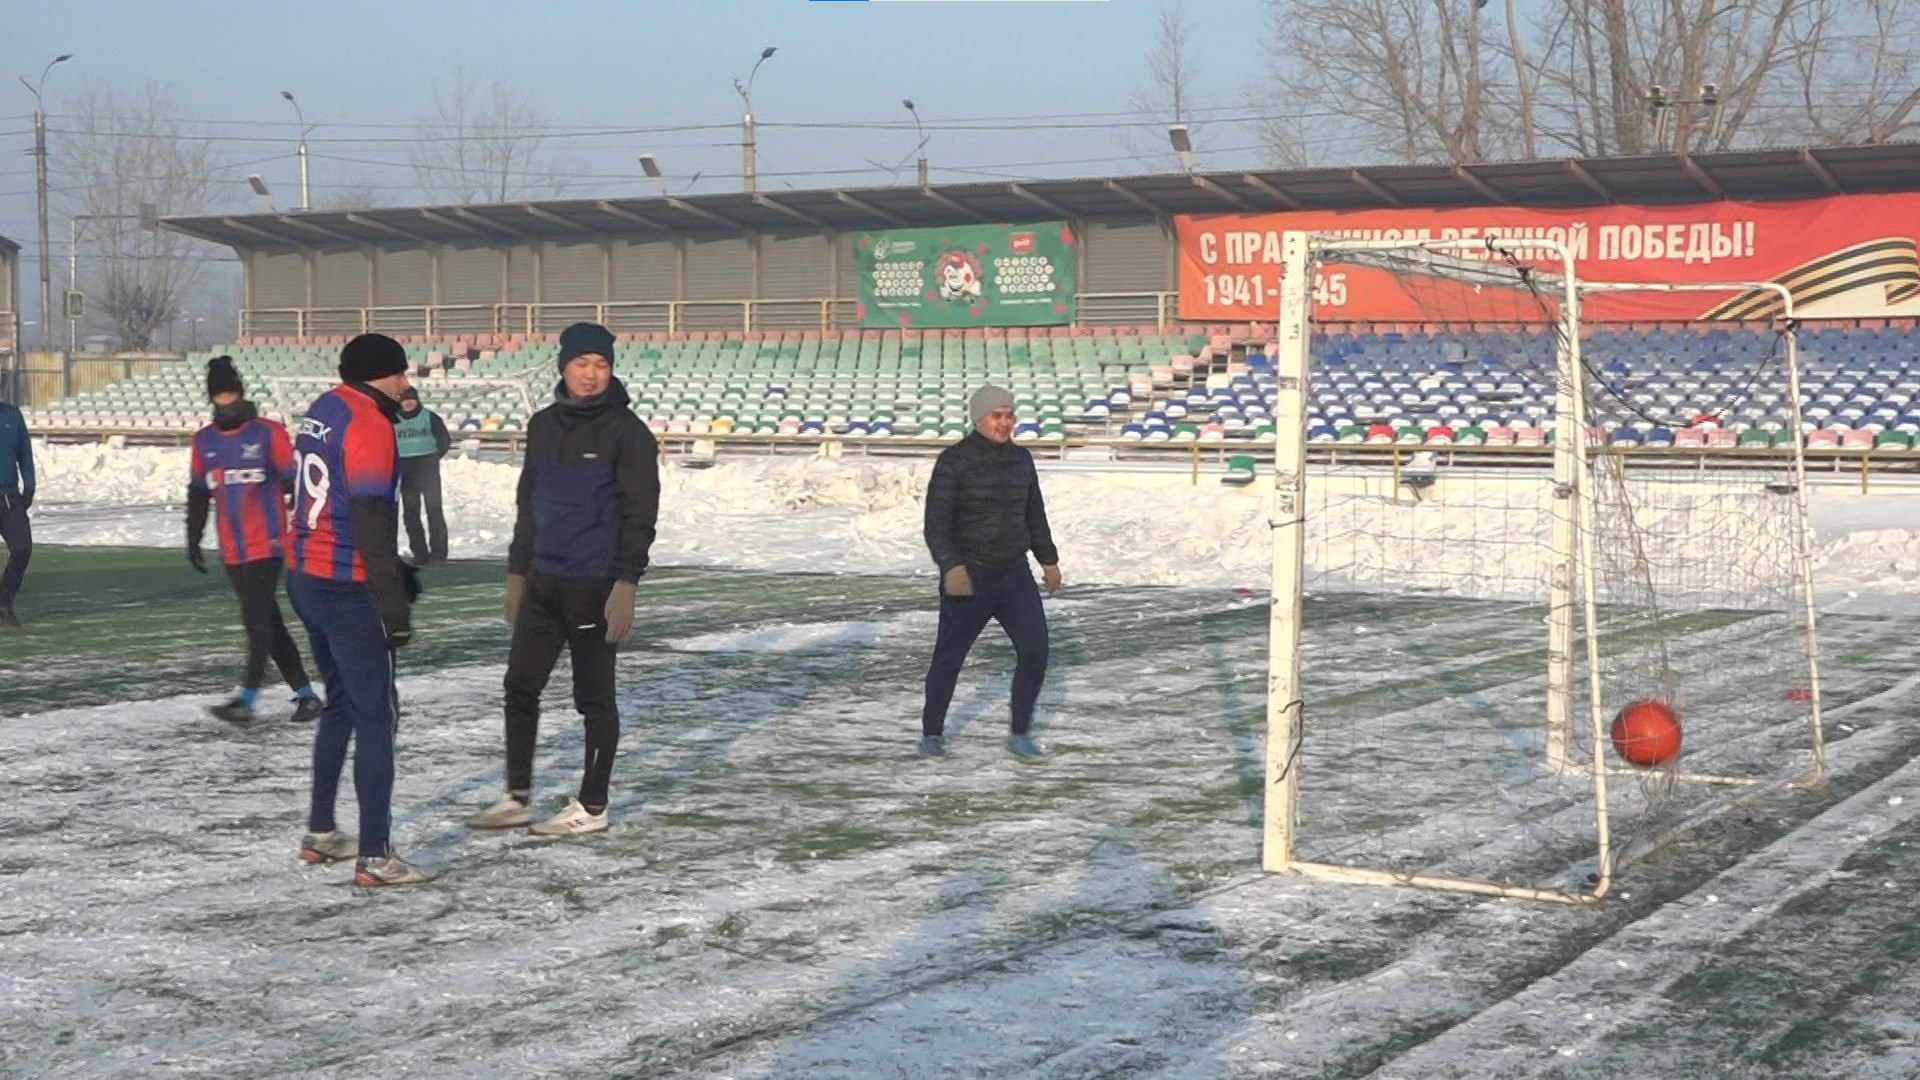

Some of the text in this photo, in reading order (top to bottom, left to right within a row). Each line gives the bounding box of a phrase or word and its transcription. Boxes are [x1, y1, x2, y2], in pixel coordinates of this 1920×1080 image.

[1200, 231, 1217, 264] С
[1599, 221, 1755, 264] ПОБЕДЫ!
[1204, 273, 1347, 306] 1941-45
